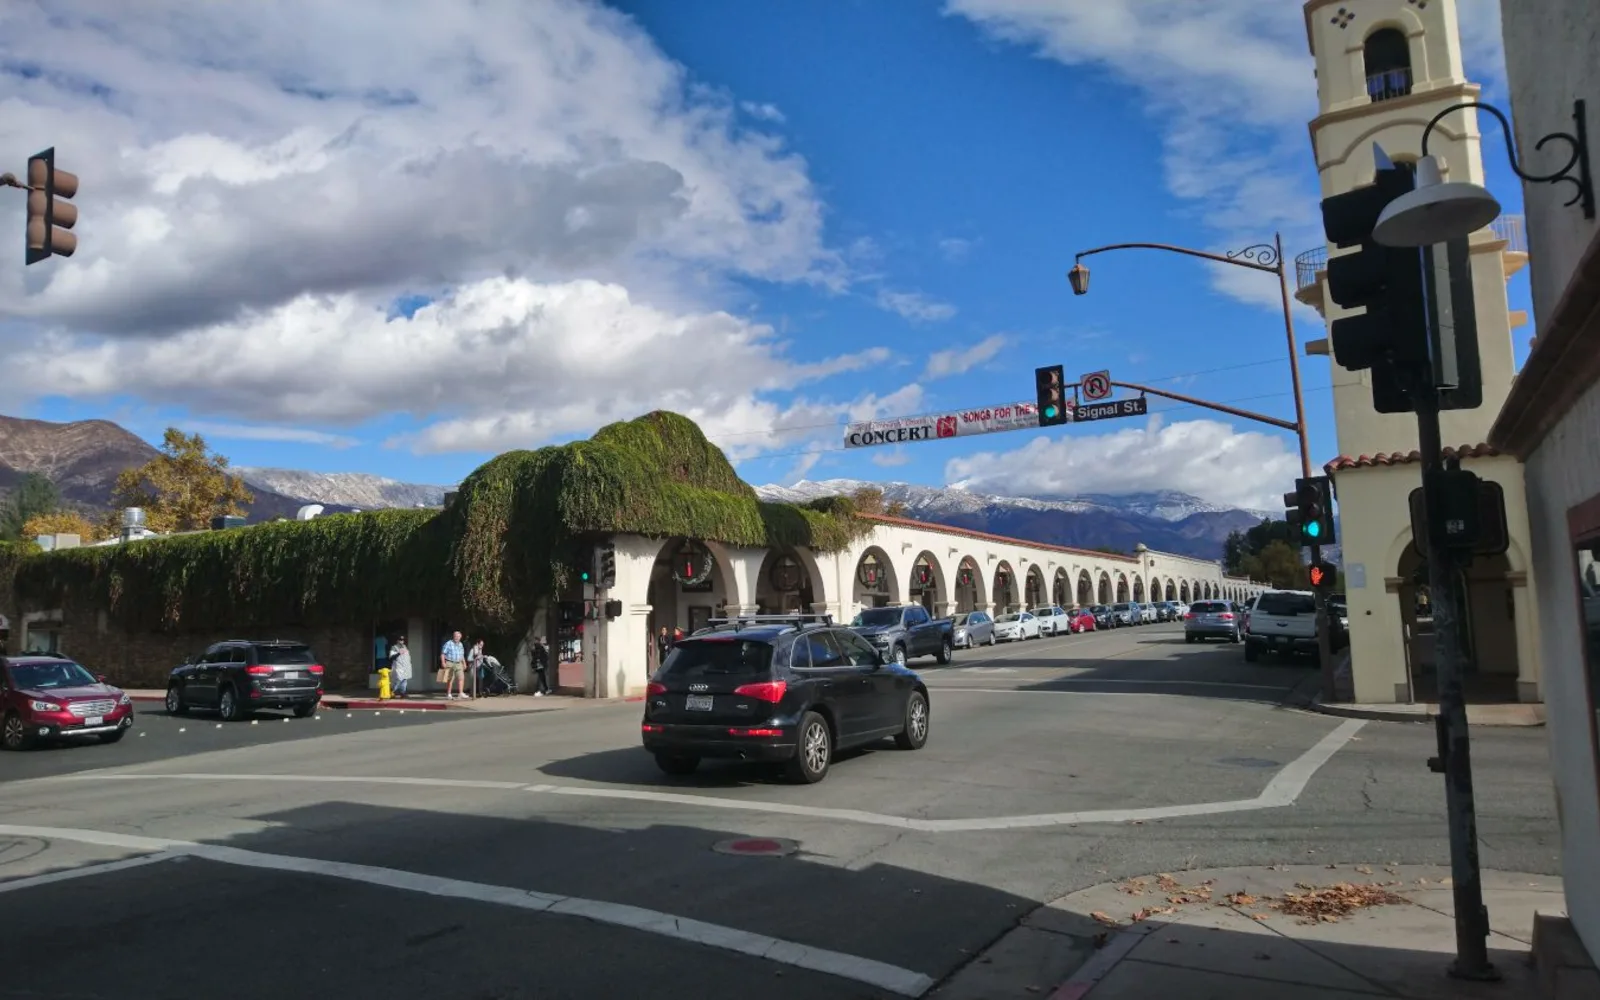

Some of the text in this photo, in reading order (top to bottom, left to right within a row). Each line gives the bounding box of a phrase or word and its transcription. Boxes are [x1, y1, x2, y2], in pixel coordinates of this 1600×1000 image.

[963, 409, 991, 423] SONGS
[994, 406, 1011, 419] FOR
[1014, 404, 1030, 417] THE
[1078, 403, 1118, 419] Signal
[1123, 401, 1143, 413] St.
[850, 426, 931, 445] CONCERT
